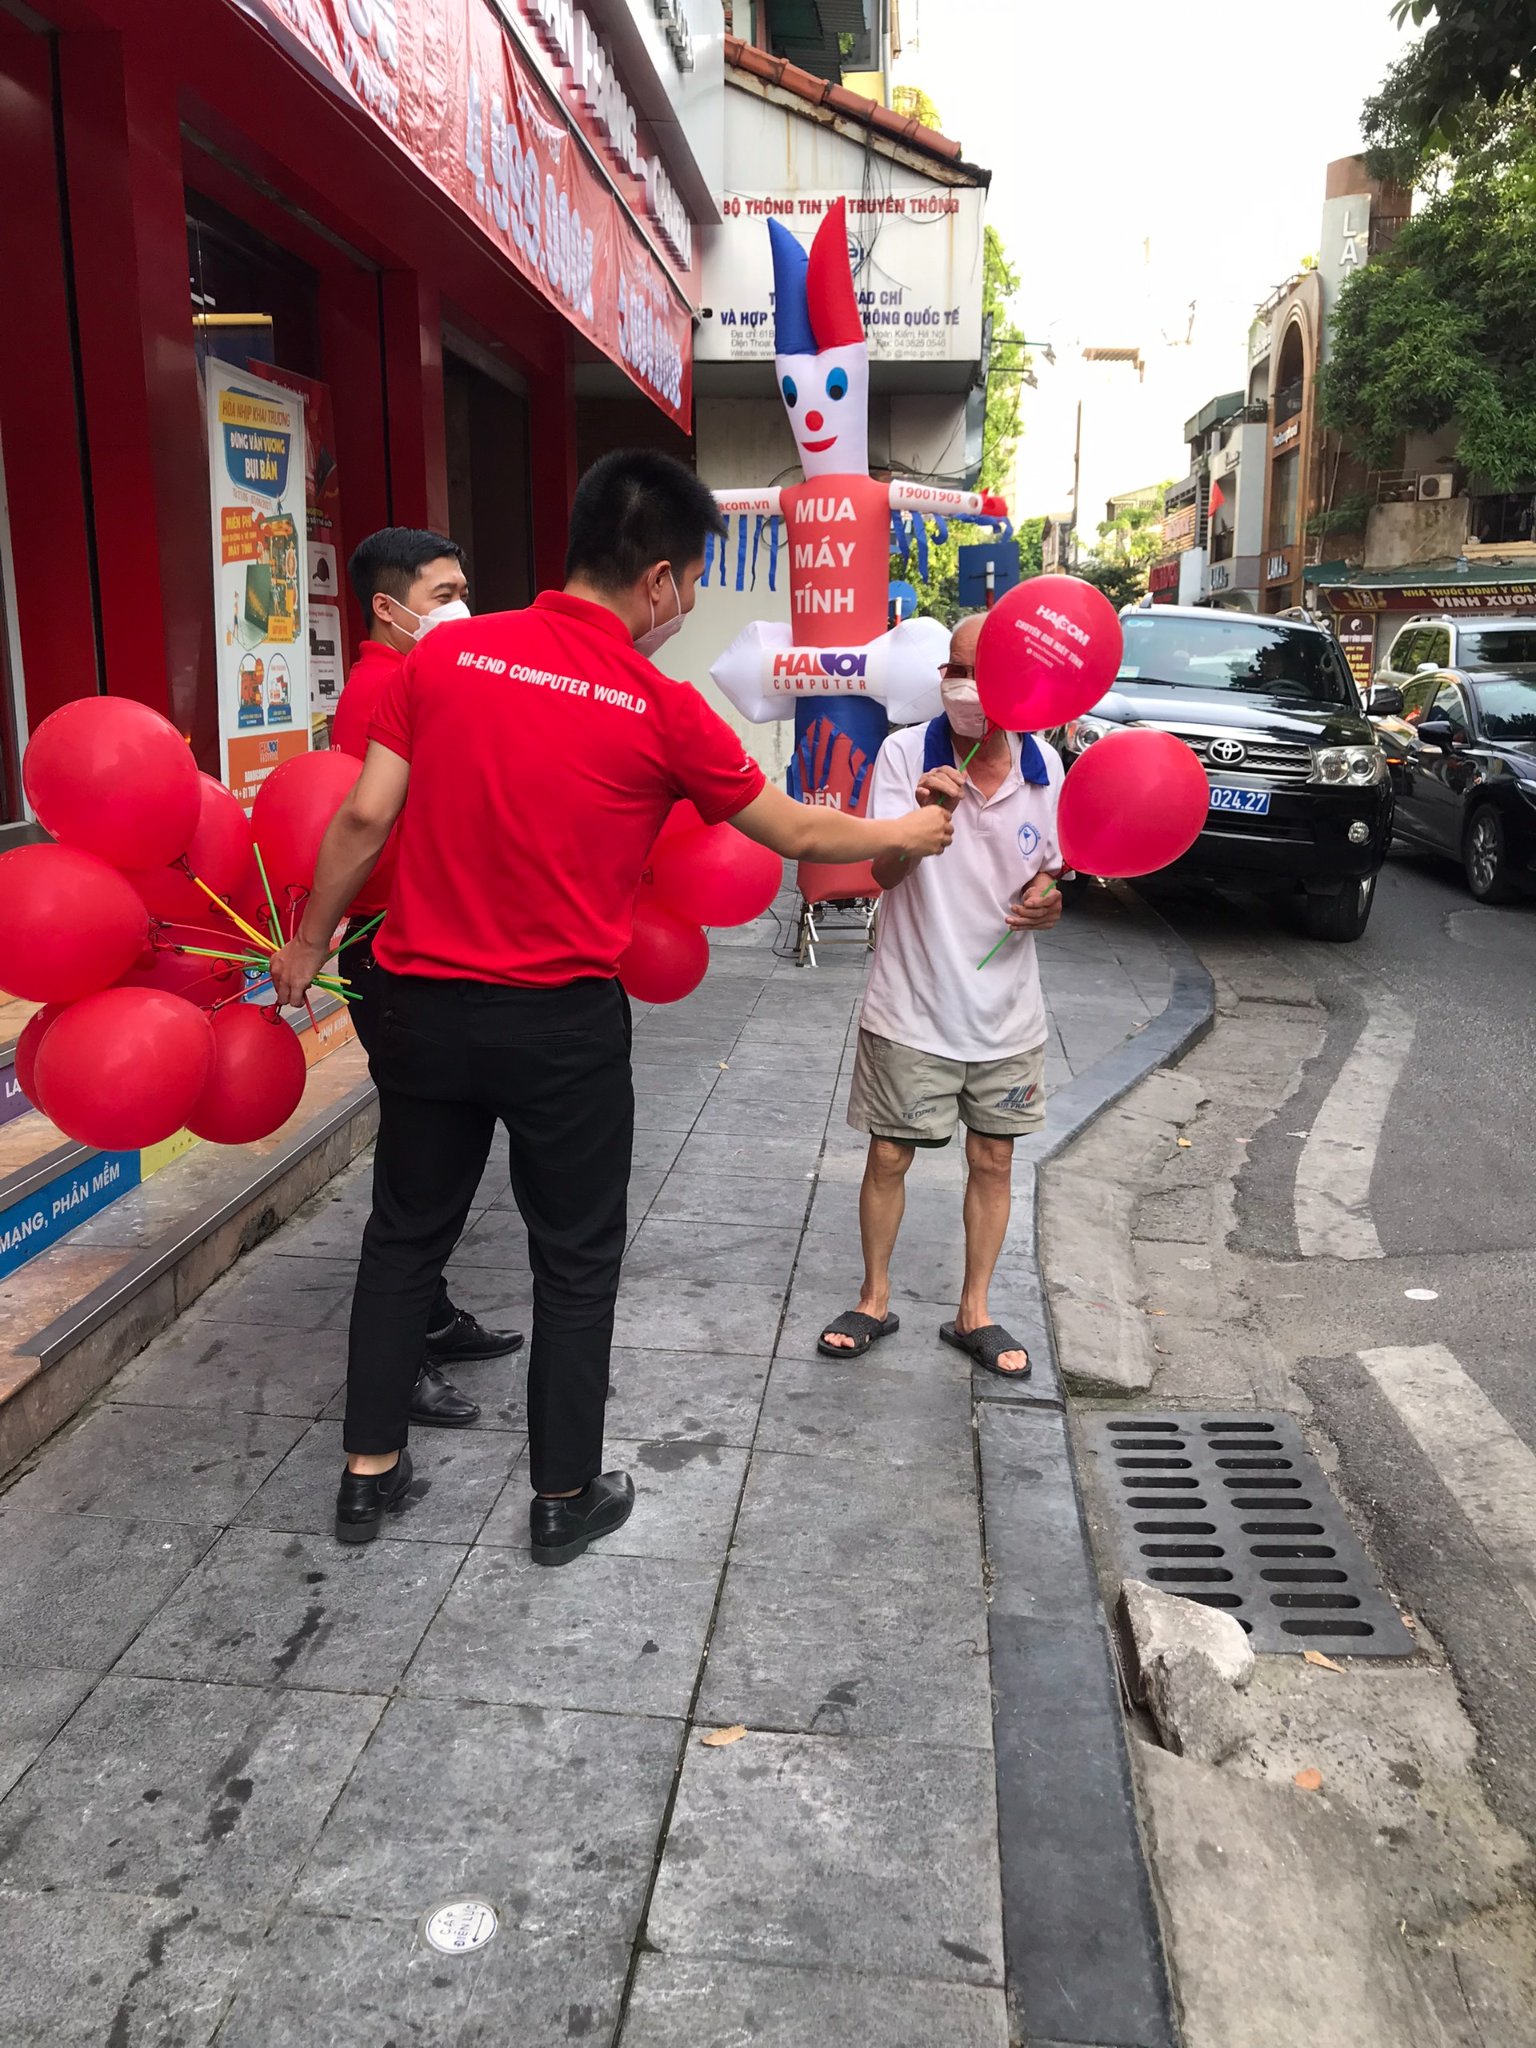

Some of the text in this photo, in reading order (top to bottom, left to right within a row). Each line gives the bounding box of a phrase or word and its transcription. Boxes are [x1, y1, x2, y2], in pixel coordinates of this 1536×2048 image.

[746, 197, 793, 215] THÔNG
[798, 199, 821, 214] TIN
[848, 194, 905, 214] TRUYỀN
[910, 197, 959, 214] THÔNG
[881, 288, 902, 305] CHÍ
[721, 309, 737, 325] VÀ
[741, 311, 767, 327] HỢP
[904, 306, 940, 325] QUỐC
[944, 306, 959, 325] TẾ
[244, 457, 259, 481] BỤI
[897, 486, 962, 504] 19001903
[795, 497, 857, 524] MUA
[795, 535, 856, 569] MÁY
[795, 581, 855, 614] TÍNH
[1035, 605, 1091, 647] HACOM
[773, 653, 868, 677] HANOI
[456, 651, 647, 714] HI-END COMPUTER WORLD
[773, 679, 867, 690] COMPUTER
[802, 785, 842, 810] ĐẾN
[1211, 789, 1268, 812] 024.27
[52, 1180, 89, 1219] PHẦN
[92, 1161, 120, 1194] MỀM
